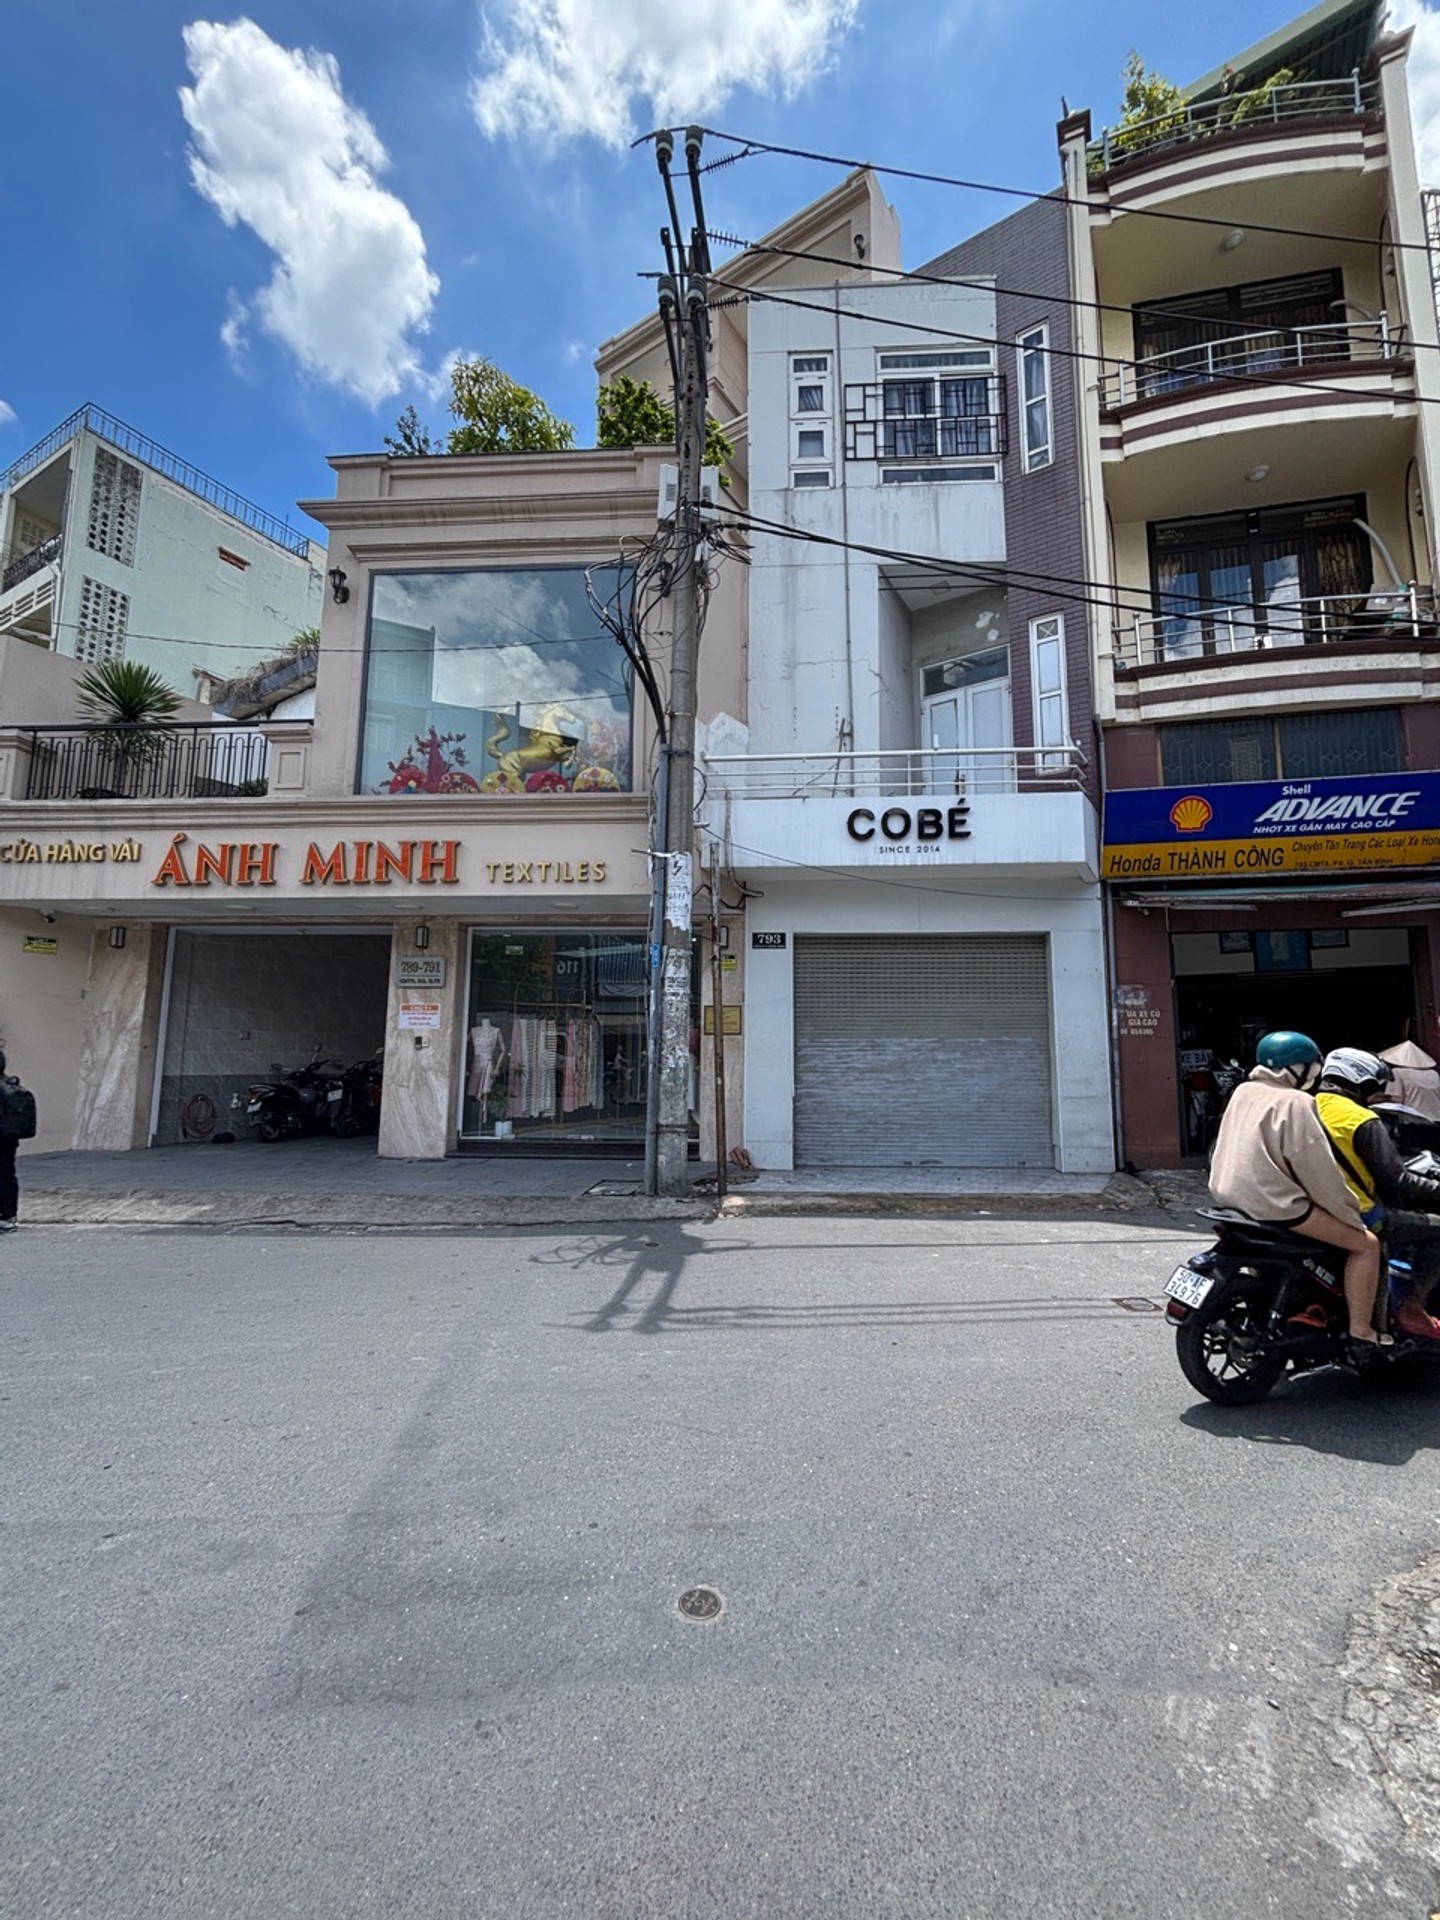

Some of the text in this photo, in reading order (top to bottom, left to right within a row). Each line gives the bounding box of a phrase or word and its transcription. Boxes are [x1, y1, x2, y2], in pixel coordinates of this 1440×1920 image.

[1282, 784, 1312, 796] Shell
[1254, 791, 1421, 823] ADVANCE
[846, 798, 972, 842] COBÉ
[1284, 824, 1297, 833] XE
[1351, 820, 1373, 829] CAO
[0, 837, 142, 864] CỬA HÀNG VẢI
[879, 845, 941, 854] SINCE 2014
[1343, 839, 1366, 852] Trang
[1368, 837, 1384, 849] Các
[1408, 834, 1419, 847] Xe
[151, 831, 462, 887] ÁNH MINH
[1109, 844, 1285, 873] Honda THÀNH CÔNG
[486, 860, 607, 883] TEXTILES
[757, 934, 782, 945] 793
[401, 961, 441, 974] 789-791
